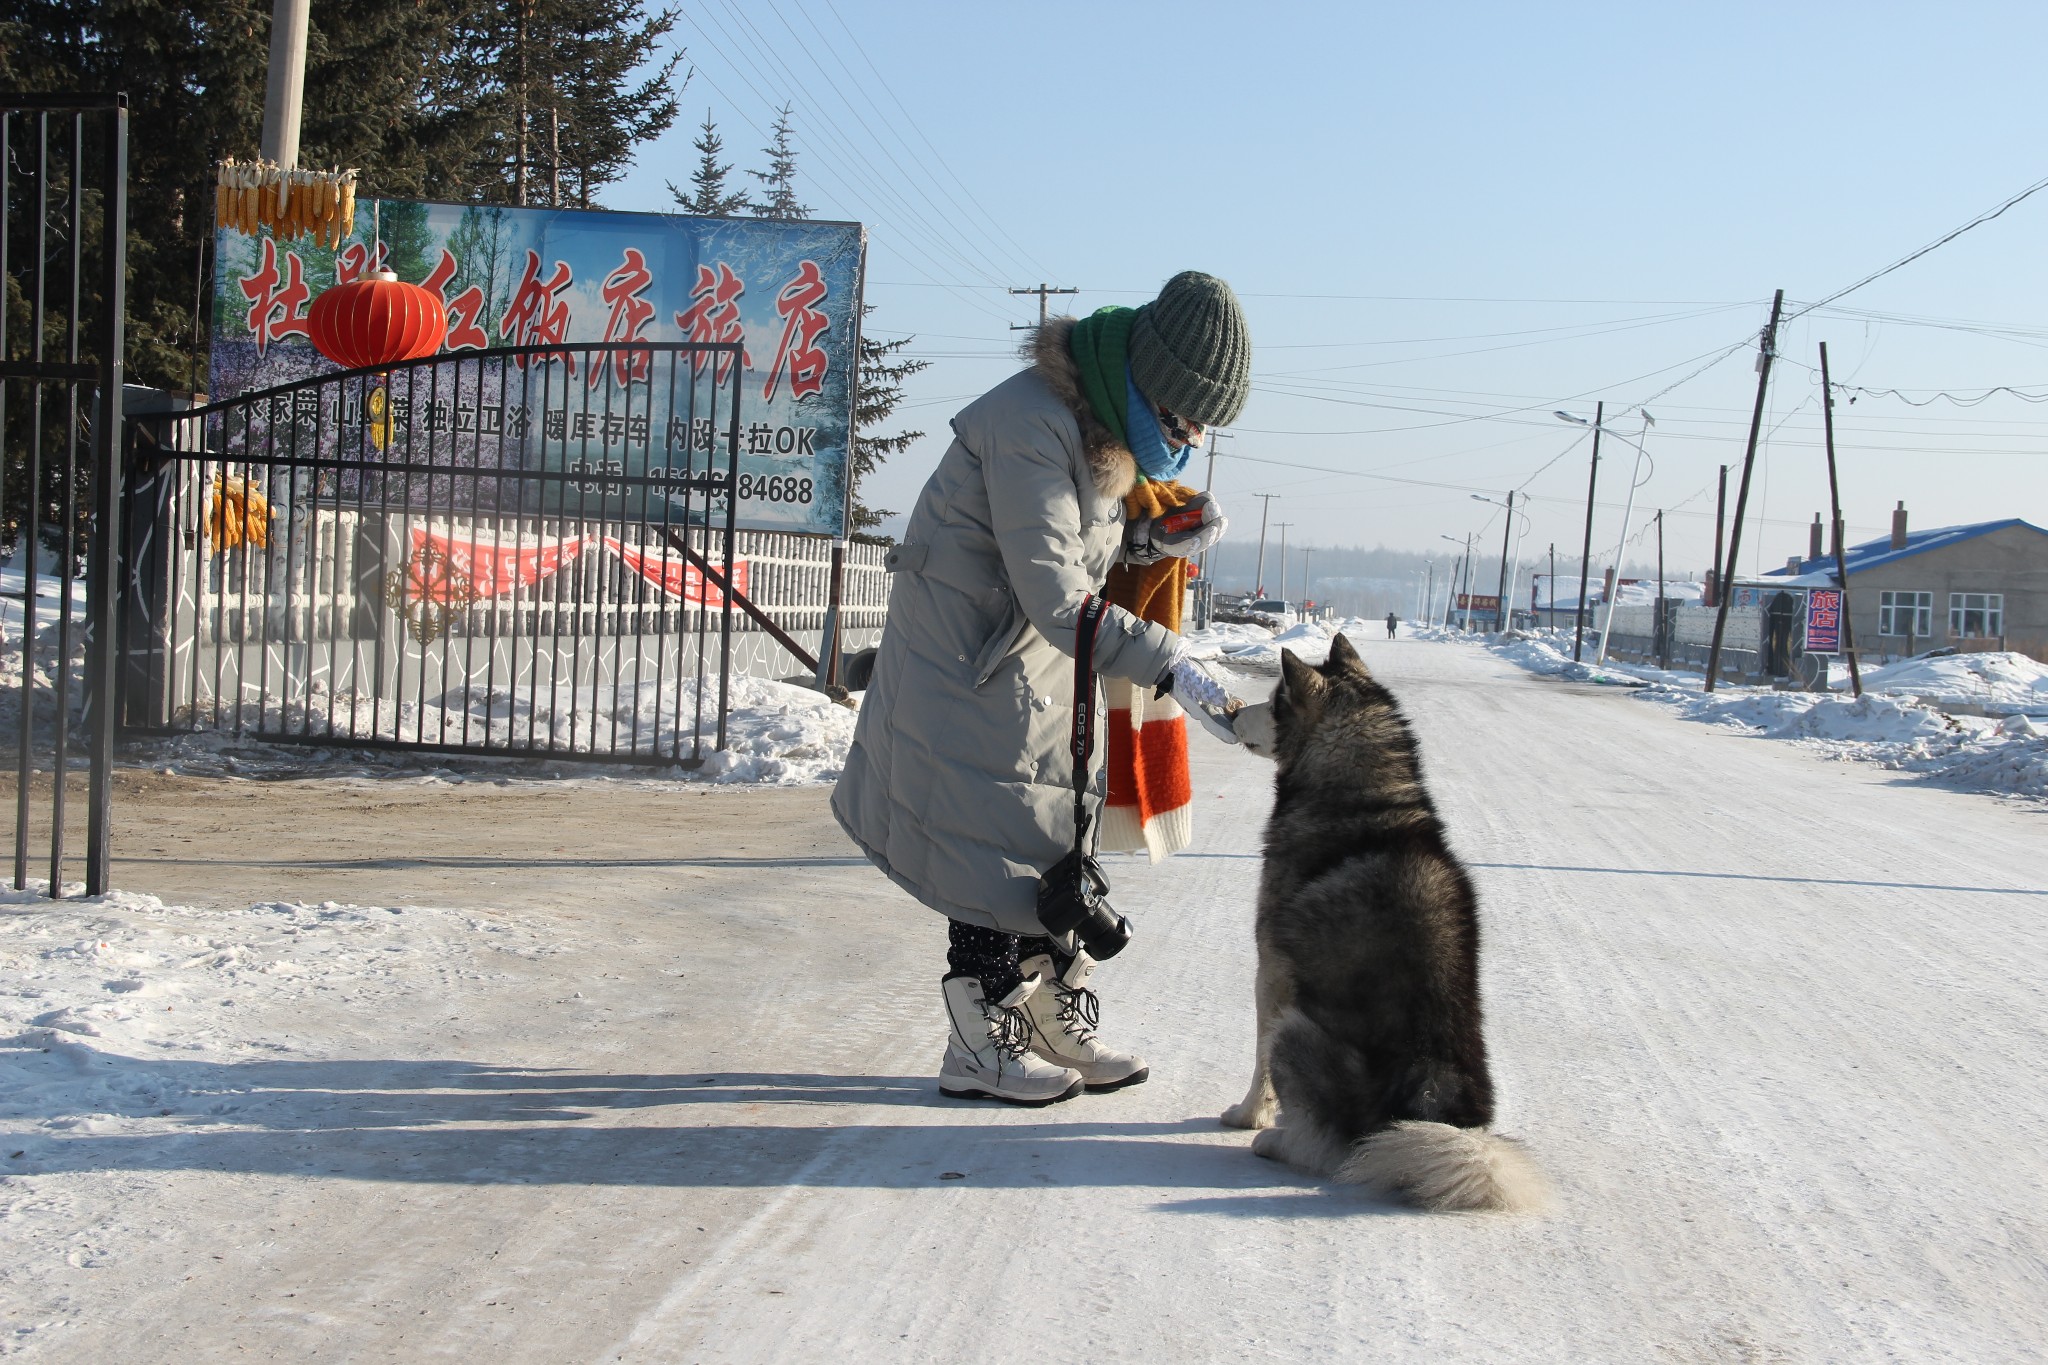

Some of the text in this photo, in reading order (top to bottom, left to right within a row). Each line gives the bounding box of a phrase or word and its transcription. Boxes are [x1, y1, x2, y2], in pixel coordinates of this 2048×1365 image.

[238, 236, 830, 404] 杜红饭店旅店
[331, 394, 409, 432] 山菜
[422, 399, 533, 440] 独立卫浴
[545, 409, 652, 448] 暖库存车
[1809, 591, 1839, 628] 旅店
[1076, 702, 1086, 756] EOS 7D
